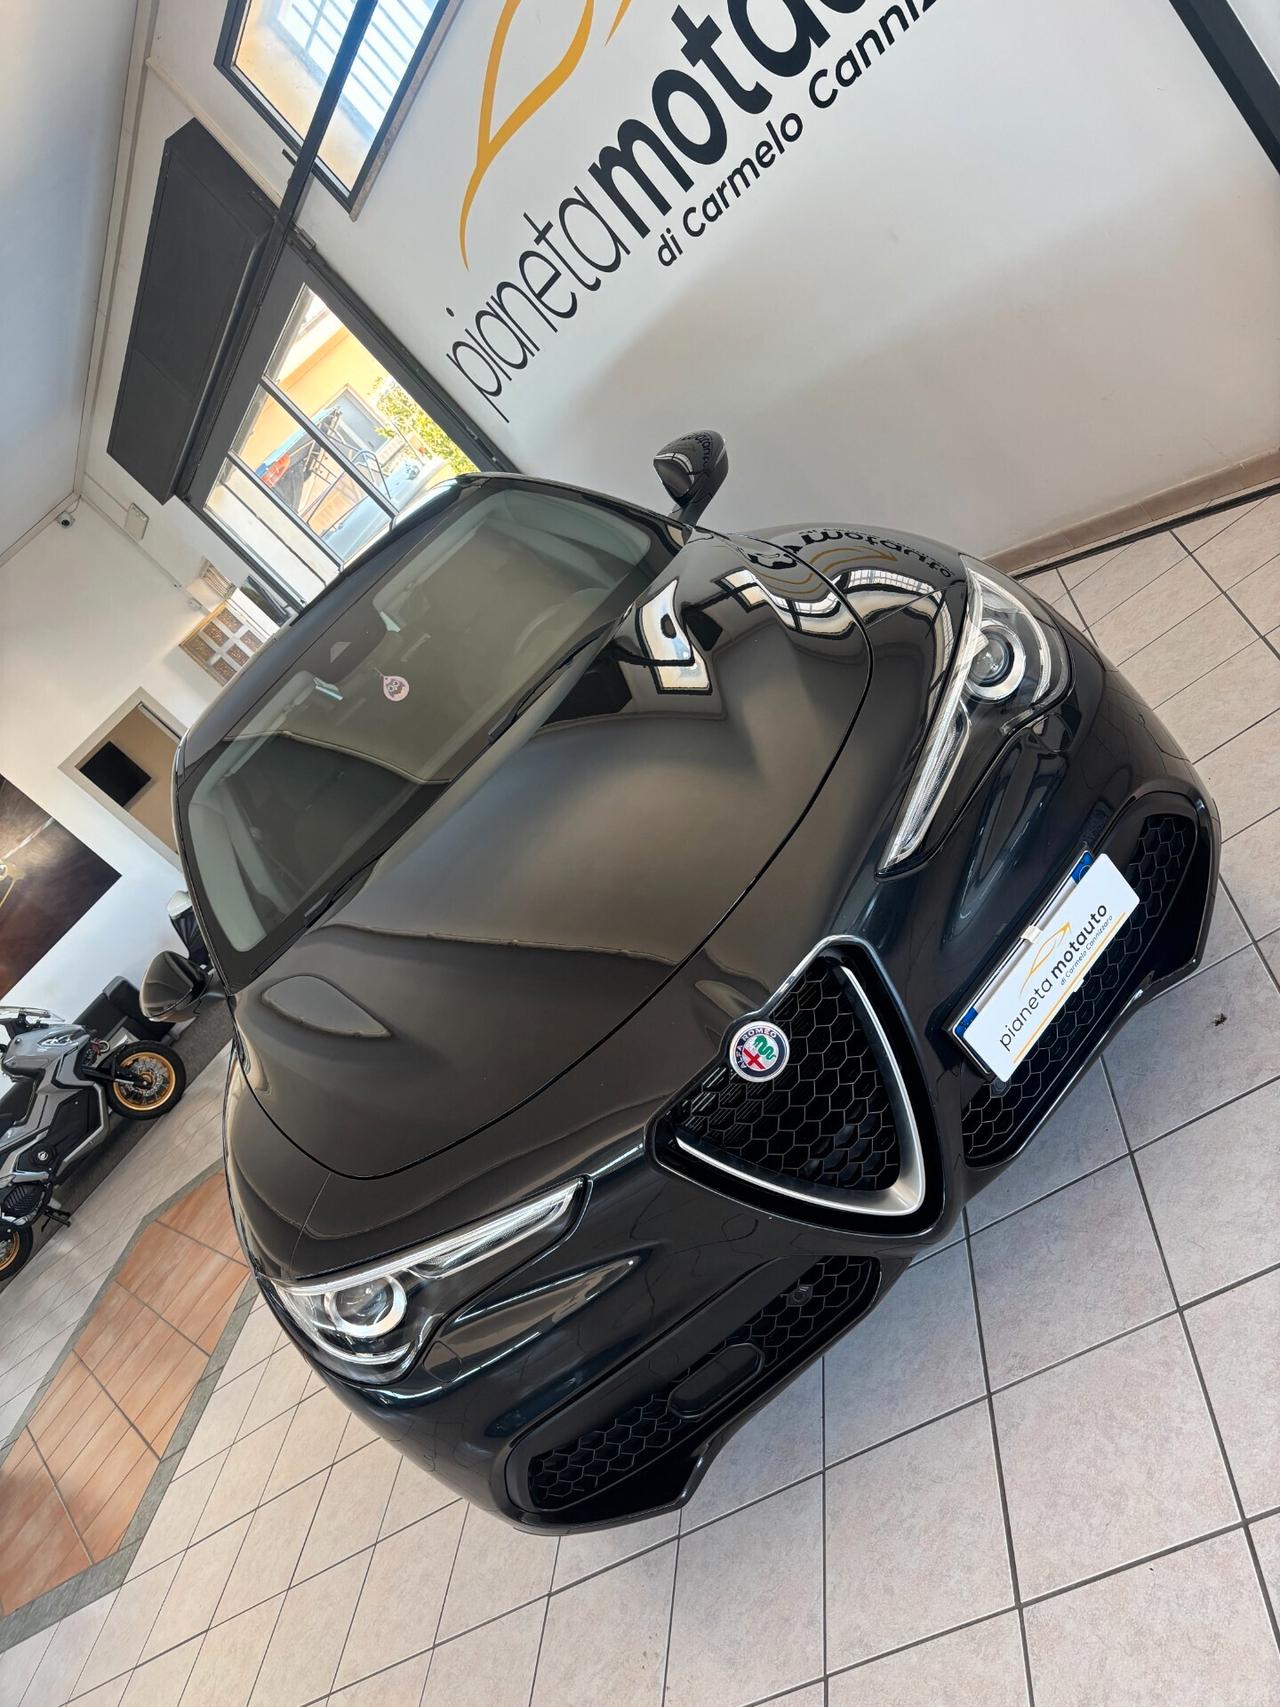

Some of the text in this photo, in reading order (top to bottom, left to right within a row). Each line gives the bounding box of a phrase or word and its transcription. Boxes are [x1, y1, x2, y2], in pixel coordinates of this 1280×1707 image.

[446, 0, 866, 424] pianetamota
[657, 227, 684, 267] di
[682, 112, 804, 238] Carmelo
[999, 904, 1108, 1052] pianeta motauto
[1065, 950, 1087, 978] Carmelo
[736, 1027, 777, 1069] ALFA ROMEO
